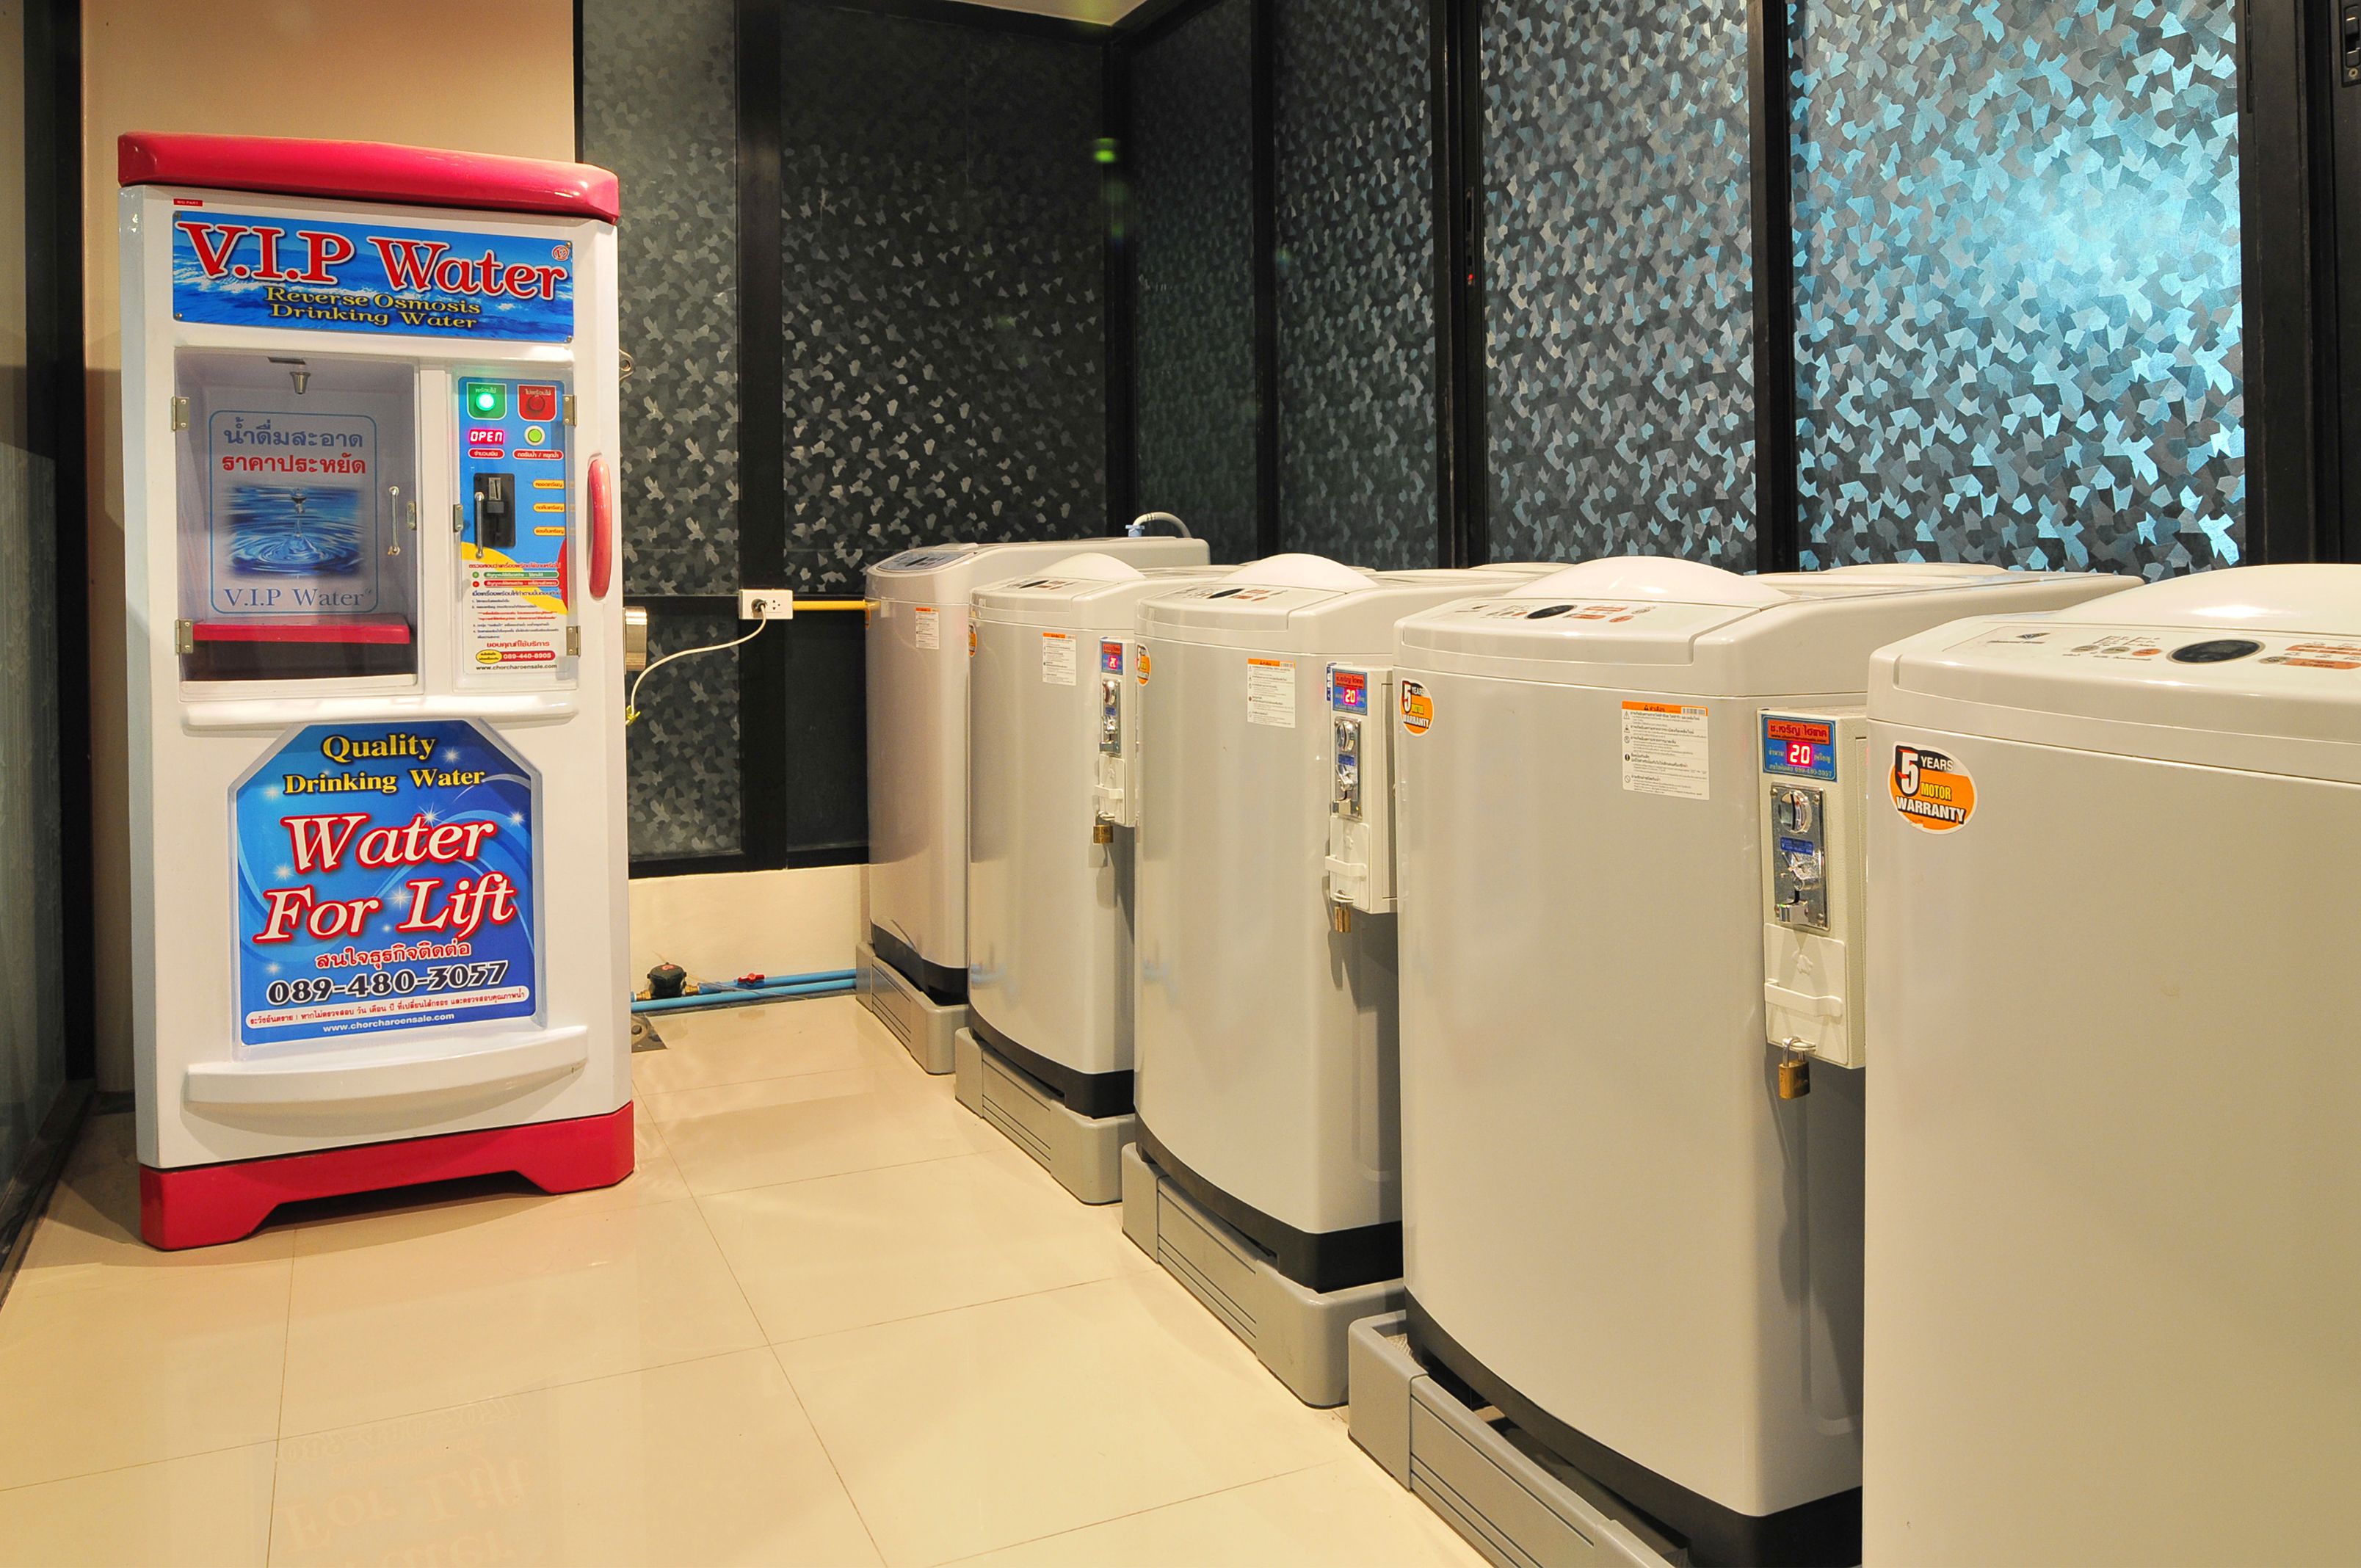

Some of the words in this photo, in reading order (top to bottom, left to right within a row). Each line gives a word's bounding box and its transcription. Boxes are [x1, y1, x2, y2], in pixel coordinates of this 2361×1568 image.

[176, 222, 354, 283] V.I.P
[366, 236, 568, 300] Water
[266, 286, 369, 307] Reverse
[374, 294, 481, 313] Osmosis
[271, 304, 388, 325] Drinking
[399, 311, 477, 328] Water
[223, 416, 363, 447] น้ำดื่มสะอาด
[222, 452, 366, 473] ราคาประหยัด
[223, 588, 281, 606] V.I.P
[292, 588, 364, 606] Water
[322, 733, 436, 763] Quality
[1790, 744, 1810, 764] 20
[1898, 748, 1919, 795] 5
[1921, 755, 1954, 772] YEARS
[284, 772, 397, 794] Drinking
[410, 769, 485, 788] Water
[1921, 782, 1952, 801] MOTOR
[1896, 796, 1965, 823] WARRANTY
[282, 812, 497, 874] Water
[253, 885, 382, 943] For
[396, 872, 517, 940] Lift
[315, 940, 471, 970] สนใจธุรกิจติดต่อ
[266, 960, 509, 1005] 089-480-3057
[323, 1012, 454, 1033] www.chorcharoensale.com
[357, 1006, 366, 1015] วัน
